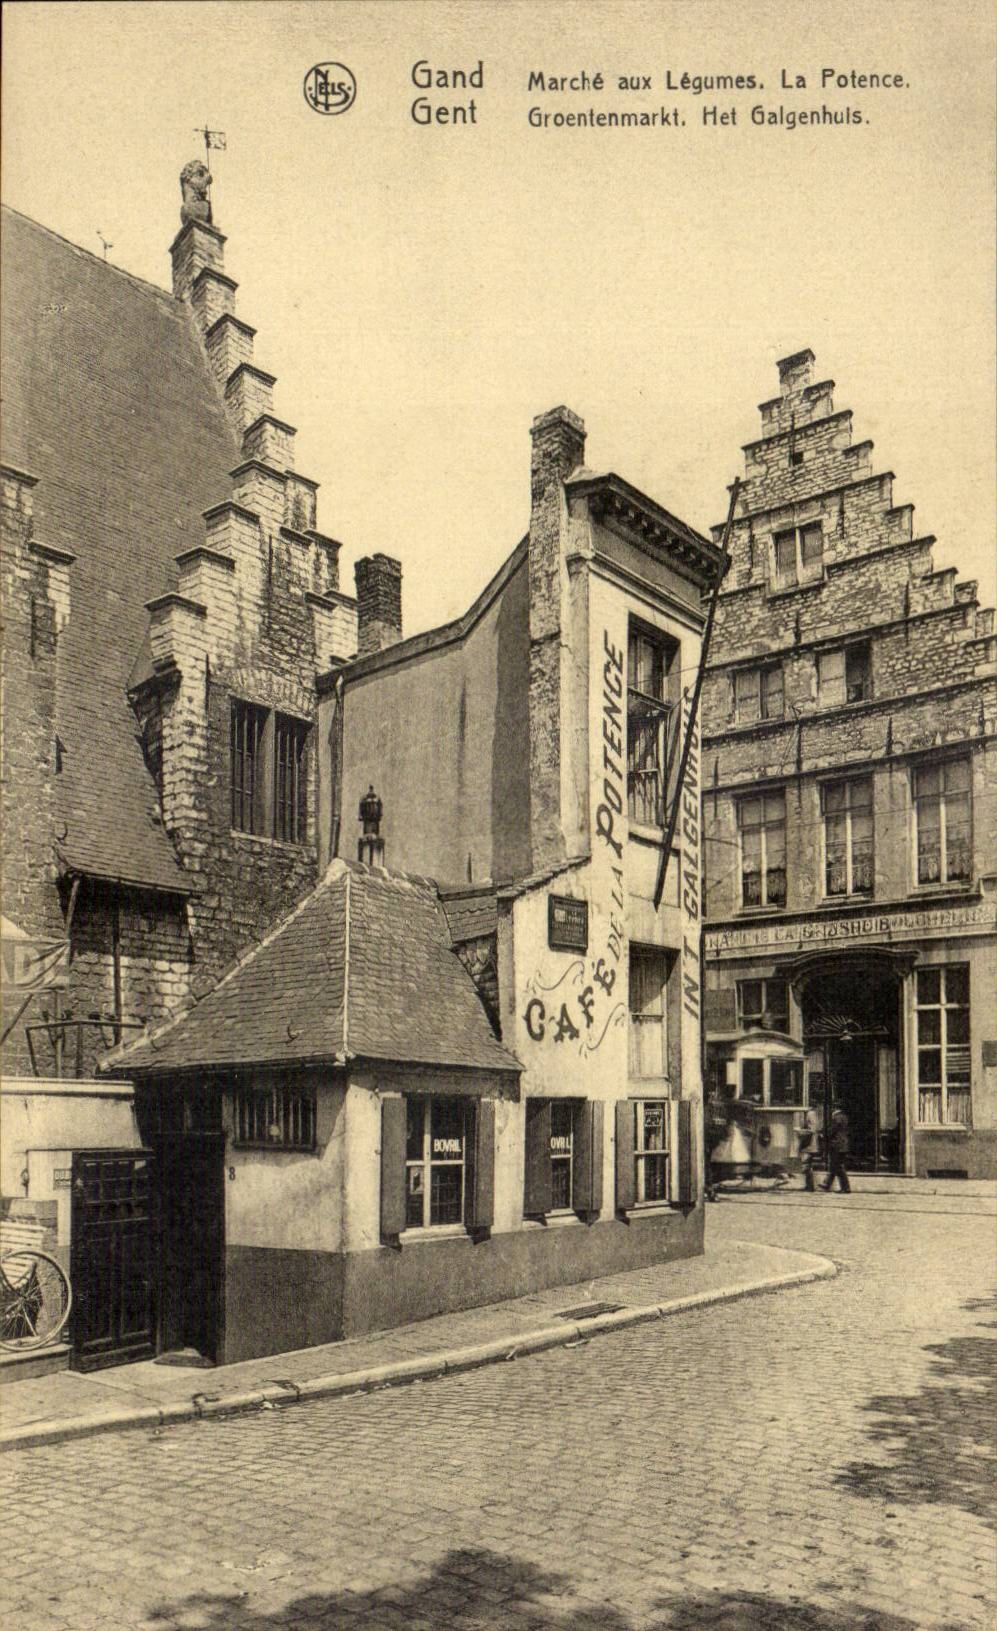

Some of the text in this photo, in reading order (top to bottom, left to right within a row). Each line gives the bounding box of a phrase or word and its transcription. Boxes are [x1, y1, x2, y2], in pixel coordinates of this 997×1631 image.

[596, 629, 624, 860] POTENCE
[611, 866, 624, 910] LA
[608, 911, 624, 961] DE
[683, 974, 699, 1021] IN
[433, 1138, 462, 1153] BOVRIL
[551, 1136, 571, 1149] OVRIL
[228, 1166, 236, 1181] 8
